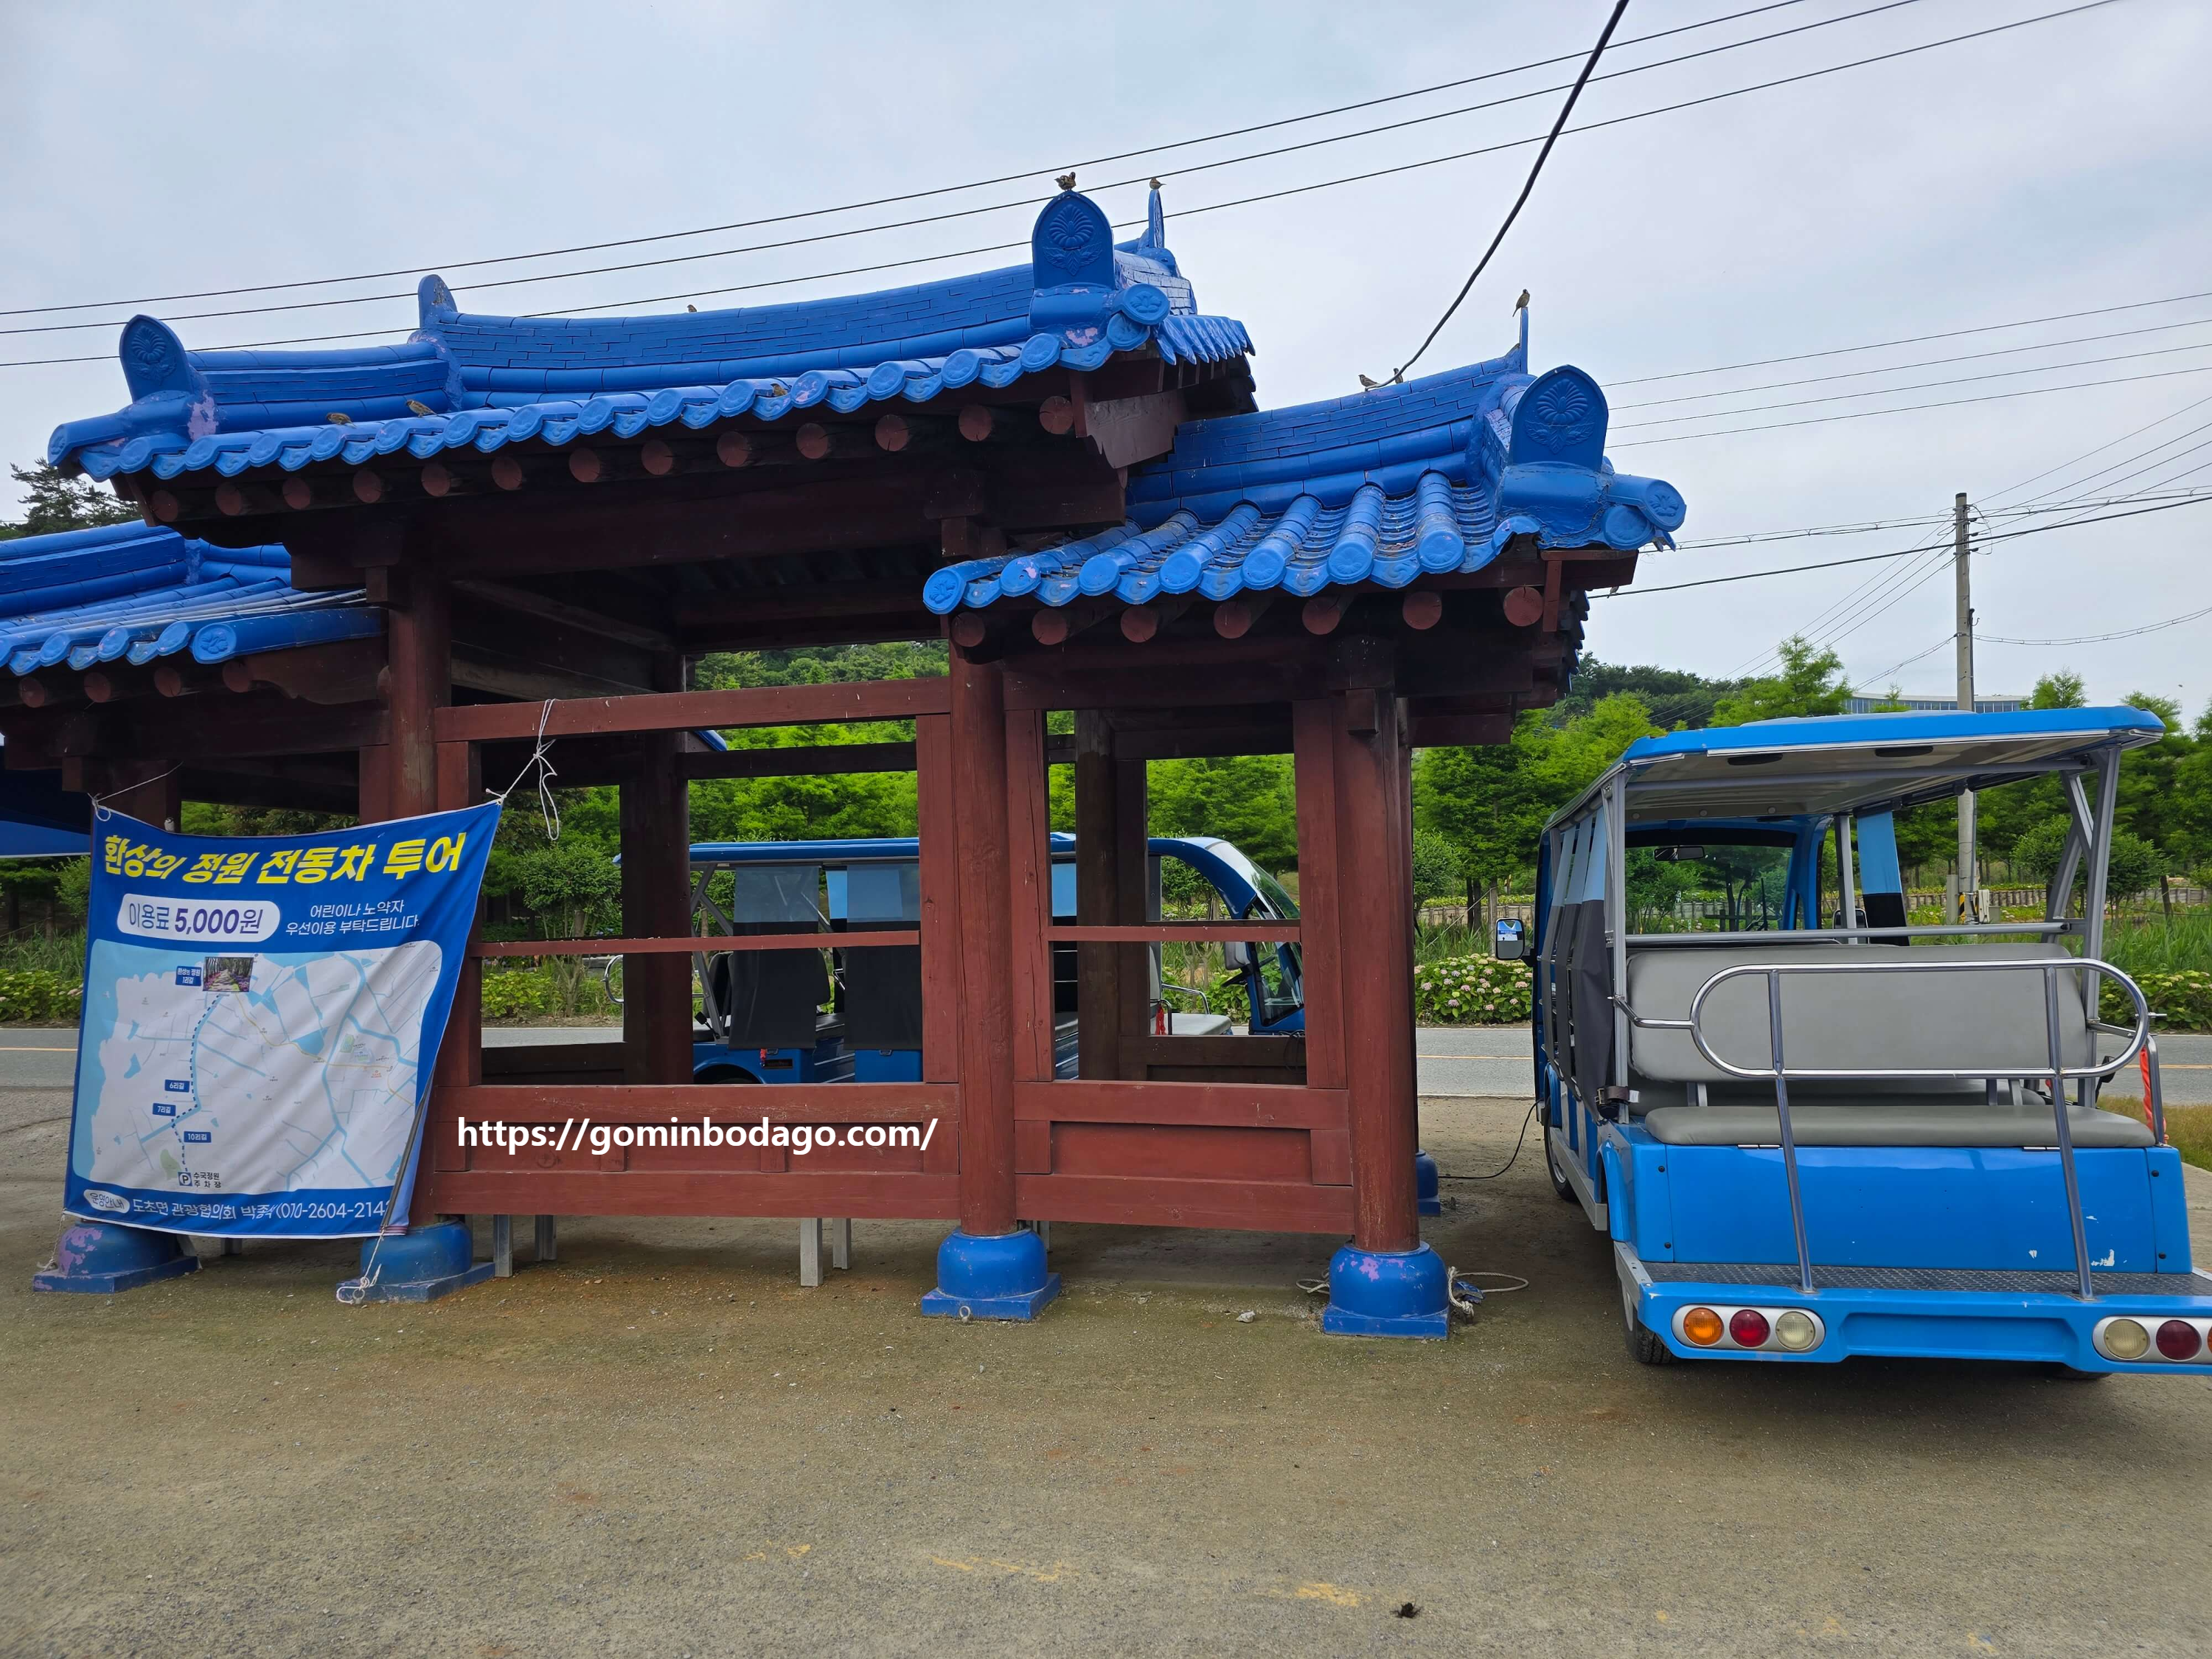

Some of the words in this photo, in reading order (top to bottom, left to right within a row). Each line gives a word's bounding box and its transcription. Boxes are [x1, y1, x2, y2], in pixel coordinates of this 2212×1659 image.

[104, 834, 187, 879] 환상의
[183, 851, 260, 884] 정원
[257, 844, 377, 884] 전동차
[383, 832, 467, 882] 투어
[310, 903, 361, 919] 어린이나
[362, 900, 405, 916] 노약자
[129, 902, 170, 931] 이용료
[174, 908, 264, 935] 5,000원
[285, 921, 337, 936] 우선이용
[169, 1082, 185, 1090] 6리길
[157, 1105, 171, 1113] 7리길
[187, 1133, 207, 1141] 10리길
[193, 1172, 220, 1180] 수국정원
[89, 1192, 125, 1210] 운영안내
[133, 1198, 169, 1216] 도초면
[172, 1203, 237, 1220] 관광협의회
